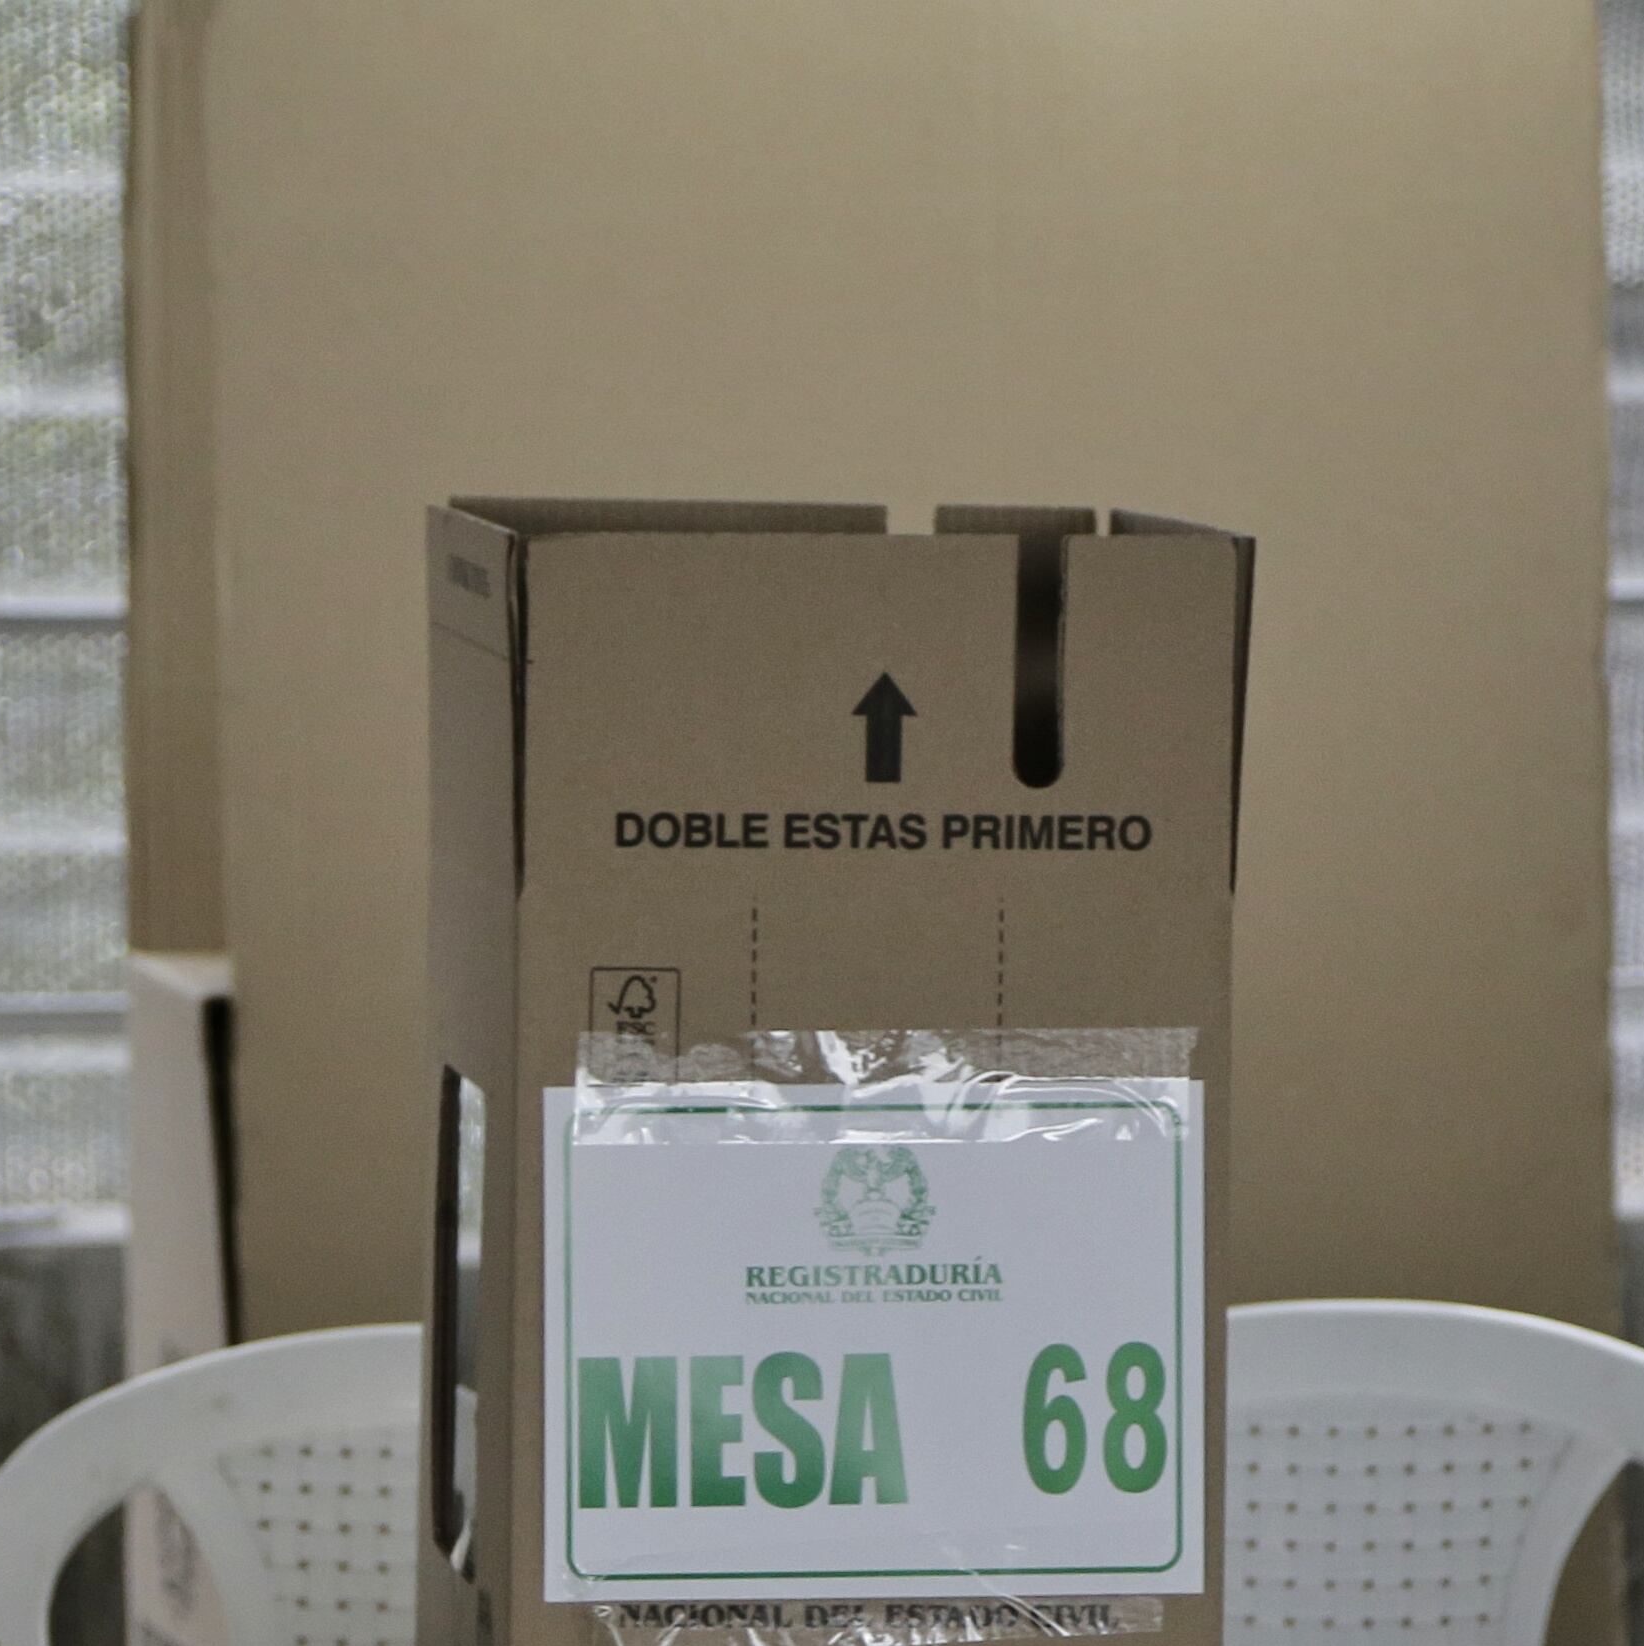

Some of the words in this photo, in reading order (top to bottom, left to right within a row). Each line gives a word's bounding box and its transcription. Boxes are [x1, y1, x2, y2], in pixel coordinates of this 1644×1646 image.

[614, 811, 770, 850] DOBLE
[783, 812, 928, 851] ESTAS
[941, 813, 1153, 853] PRIMERO
[745, 1255, 1003, 1288] REGISTRADURÍA
[745, 1291, 831, 1305] NACIONAL
[840, 1290, 875, 1304] DEL
[882, 1289, 953, 1303] ESTADO
[957, 1288, 1003, 1303] CIVIL
[577, 1351, 909, 1511] MESA
[1022, 1341, 1168, 1496] 68
[619, 1603, 793, 1628] NACIONAL
